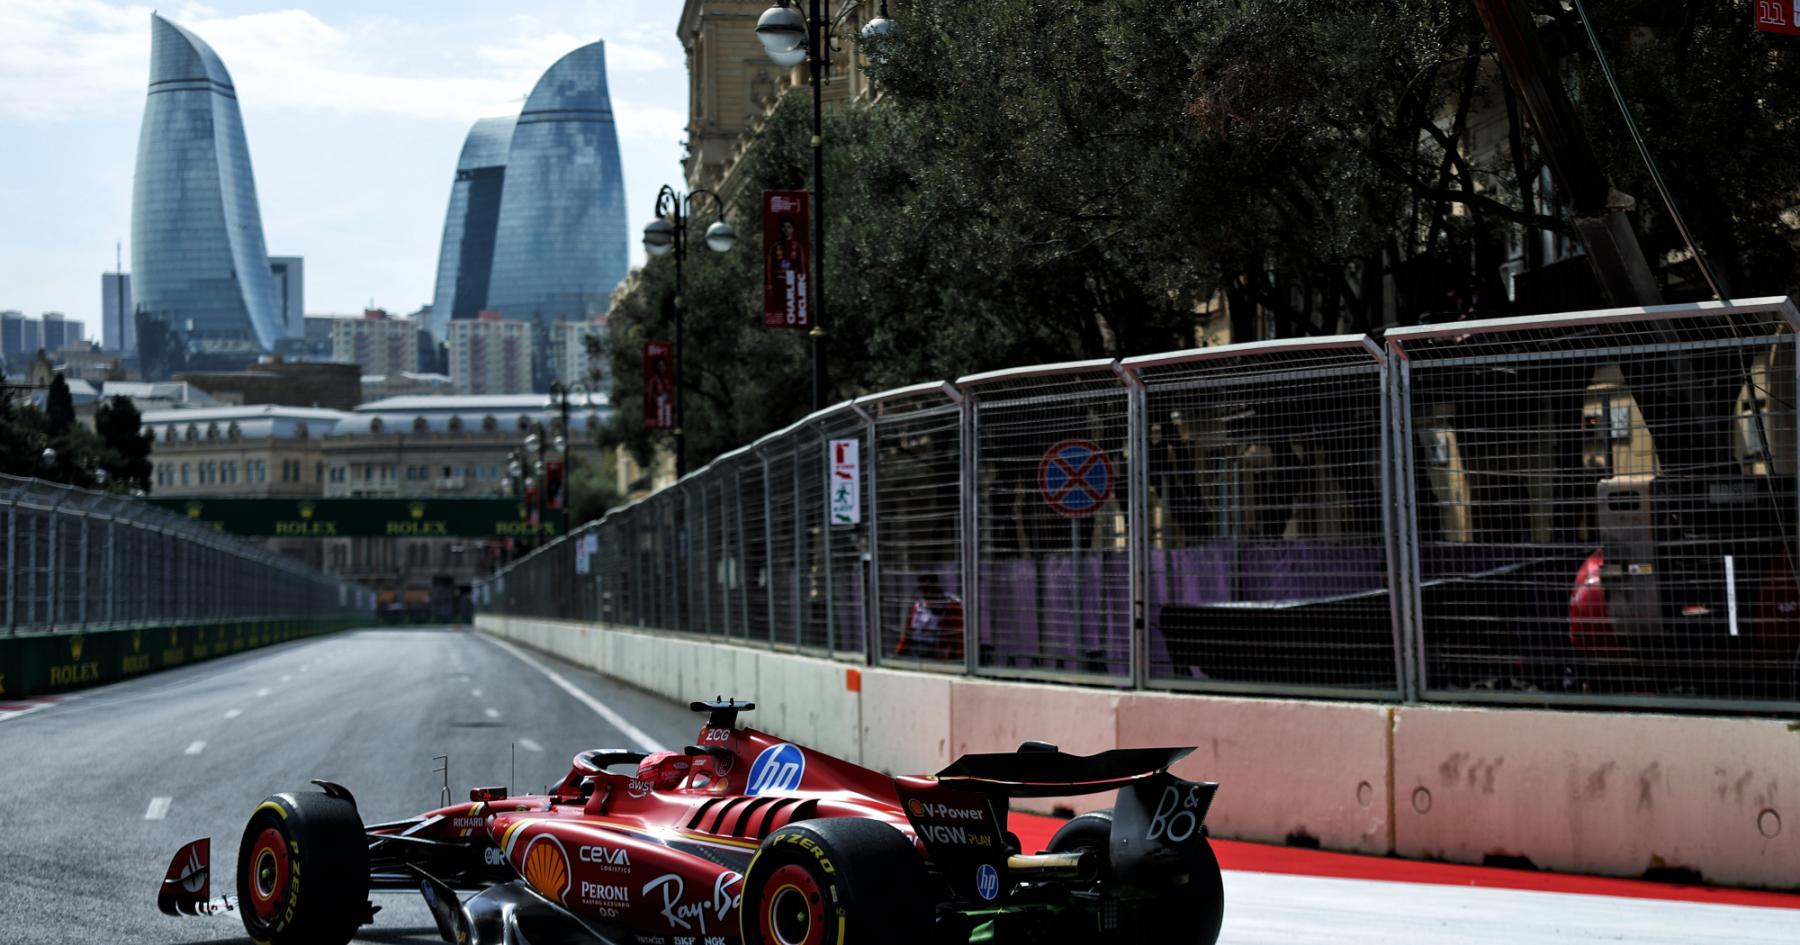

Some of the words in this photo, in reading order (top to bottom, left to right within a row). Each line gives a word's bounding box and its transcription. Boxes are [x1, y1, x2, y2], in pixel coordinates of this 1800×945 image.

[276, 521, 336, 535] ROLEX
[387, 521, 447, 535] ROLEX
[50, 662, 99, 688] ROLEX
[706, 728, 731, 742] ZCG
[628, 778, 651, 792] aws
[922, 802, 985, 821] V-Power
[453, 817, 484, 828] RICHARD
[920, 824, 967, 844] VGW
[967, 833, 992, 847] PLAY
[787, 833, 836, 874] ZERO
[600, 865, 631, 875] LOGISTICS
[581, 880, 630, 902] PERONI
[979, 864, 997, 900] hp
[285, 860, 300, 924] ZERO
